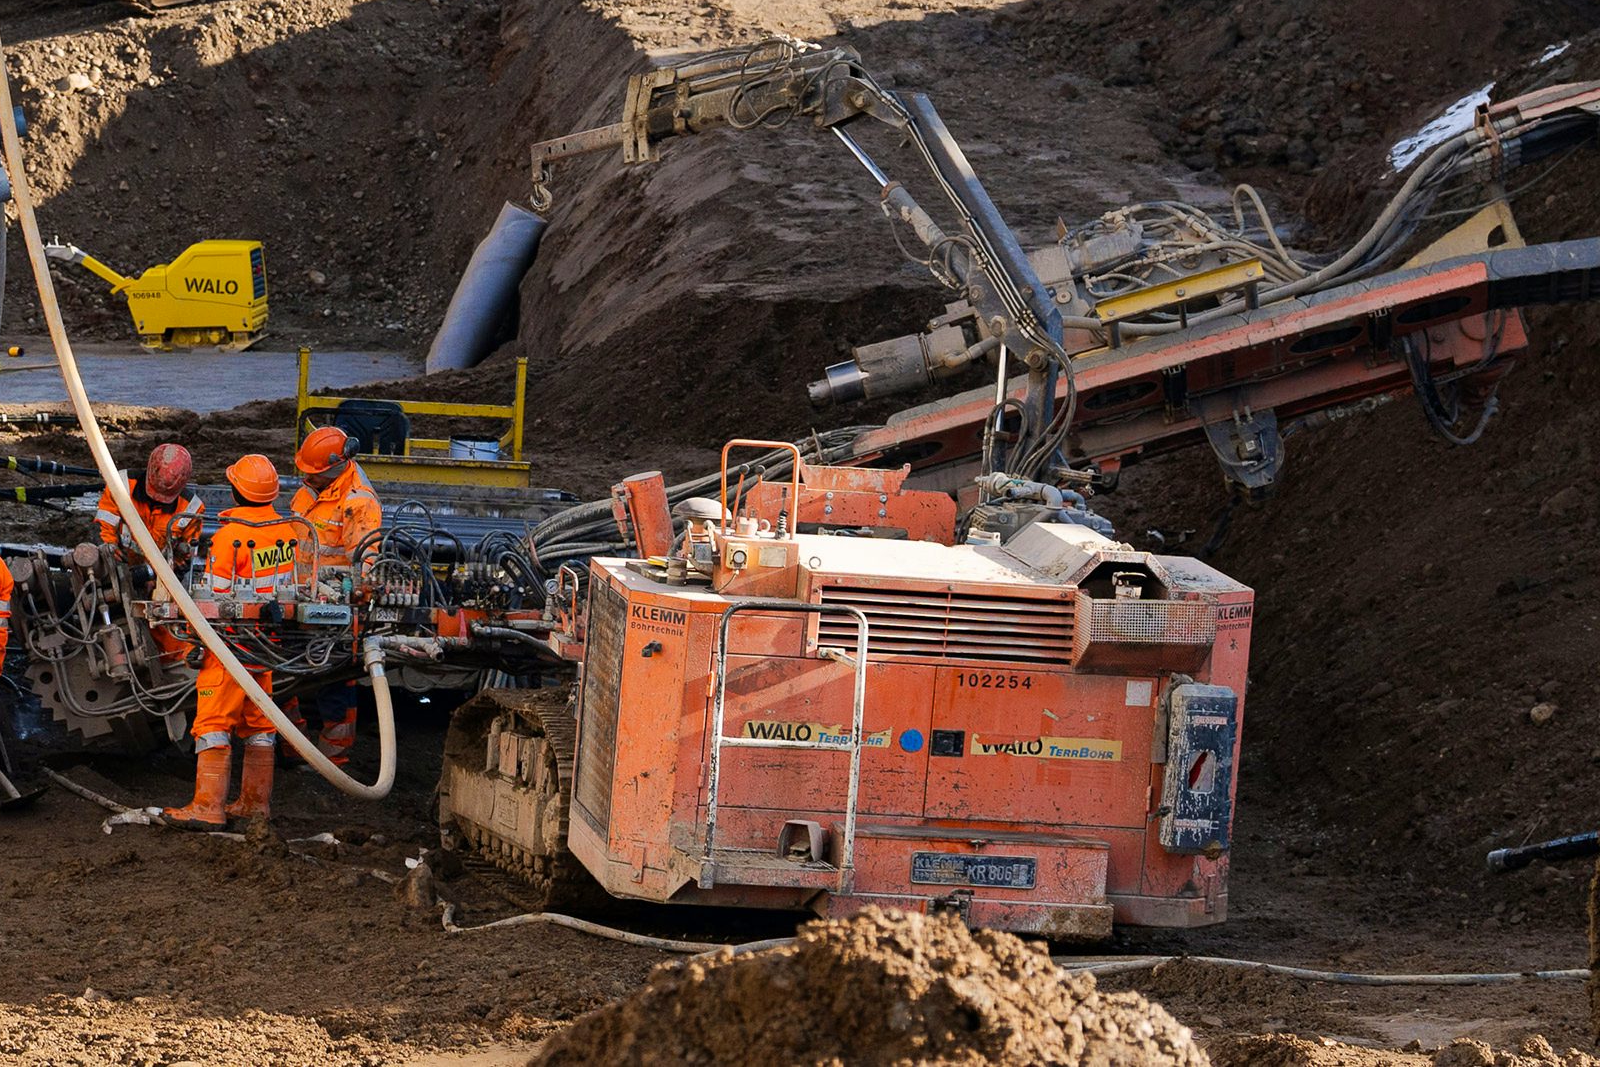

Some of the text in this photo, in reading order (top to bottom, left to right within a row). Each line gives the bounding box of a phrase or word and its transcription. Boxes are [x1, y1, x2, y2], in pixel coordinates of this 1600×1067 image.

[184, 276, 239, 295] WALO
[257, 544, 294, 568] WALO
[632, 605, 686, 626] KLEMM
[1217, 605, 1252, 621] KLEMM
[630, 621, 685, 637] Bohrtechnik
[957, 672, 1033, 690] 102254
[747, 721, 812, 742] WALO
[980, 738, 1044, 756] WALO
